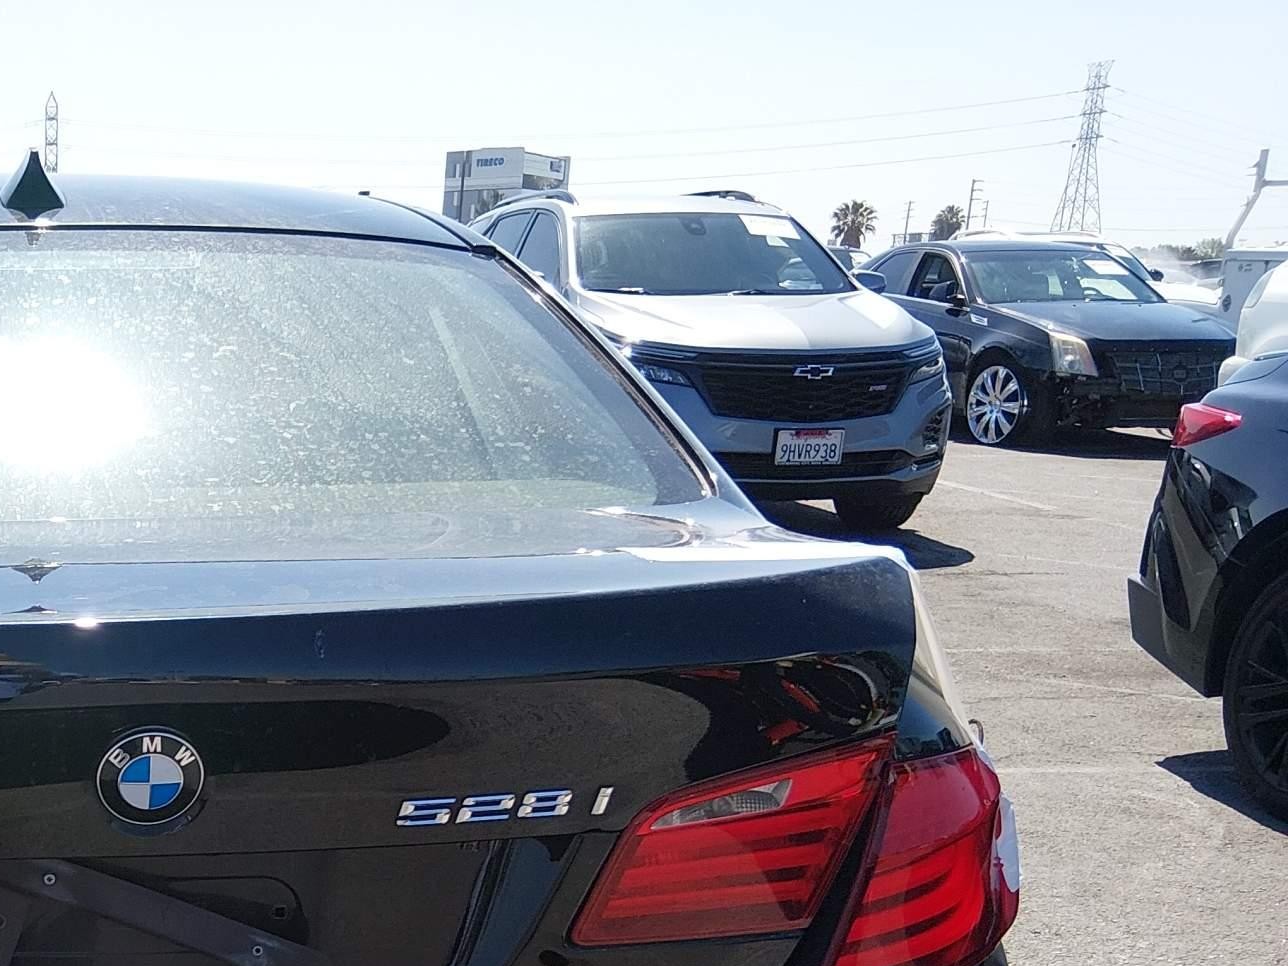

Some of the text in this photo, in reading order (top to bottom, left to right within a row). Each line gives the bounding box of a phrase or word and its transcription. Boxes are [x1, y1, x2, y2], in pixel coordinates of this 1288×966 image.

[476, 157, 504, 168] TIRECO
[780, 443, 838, 460] 9HVR938
[108, 736, 196, 769] BMW
